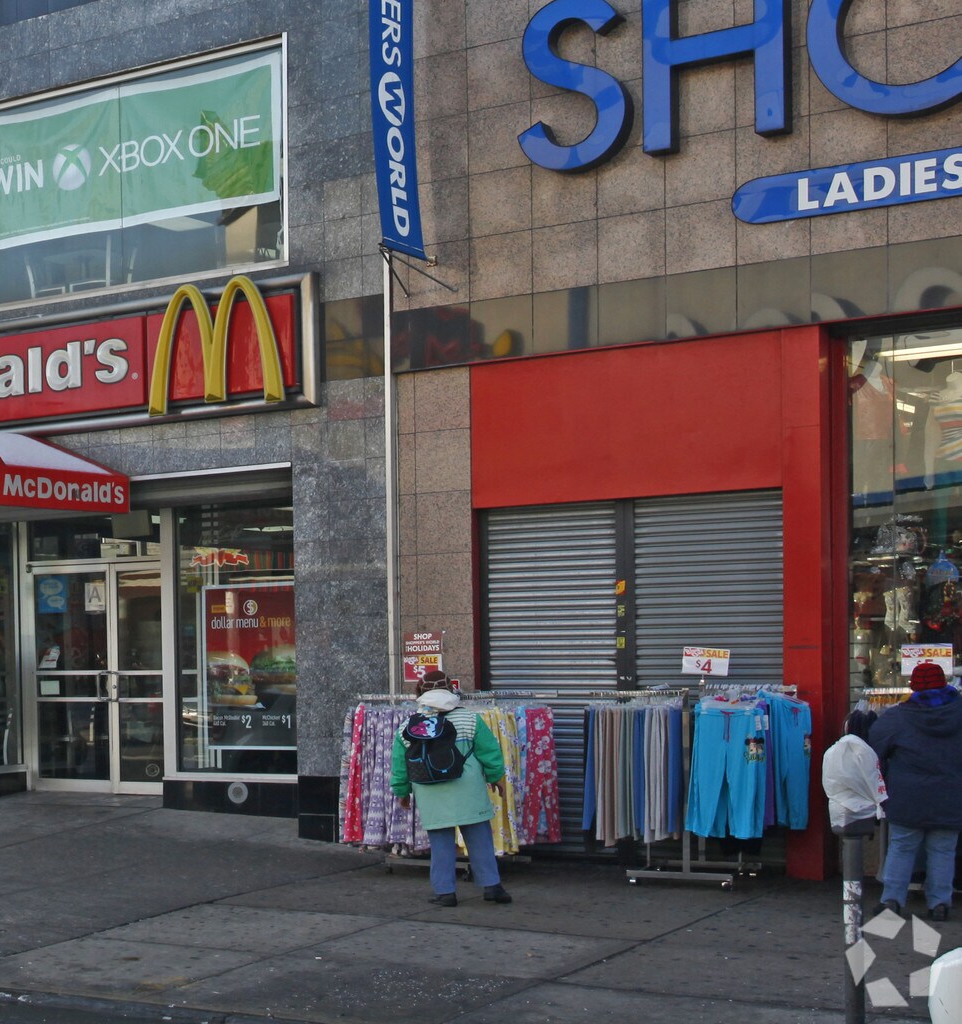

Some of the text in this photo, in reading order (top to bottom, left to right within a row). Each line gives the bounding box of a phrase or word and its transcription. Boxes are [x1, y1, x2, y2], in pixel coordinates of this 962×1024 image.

[98, 129, 184, 177] XBOX
[188, 114, 261, 158] ONE
[0, 154, 21, 165] COULD
[378, 71, 411, 238] WORLD
[797, 152, 962, 211] LADIES
[2, 473, 126, 505] McDonald's
[211, 616, 292, 630] dollar menu & more
[407, 644, 440, 652] HOLIDAYS
[706, 649, 729, 658] SALE
[926, 648, 952, 658] SALE
[420, 656, 438, 664] SALE
[695, 658, 713, 674] $4
[413, 665, 426, 678] $5
[241, 714, 252, 729] $2
[281, 714, 292, 729] $1
